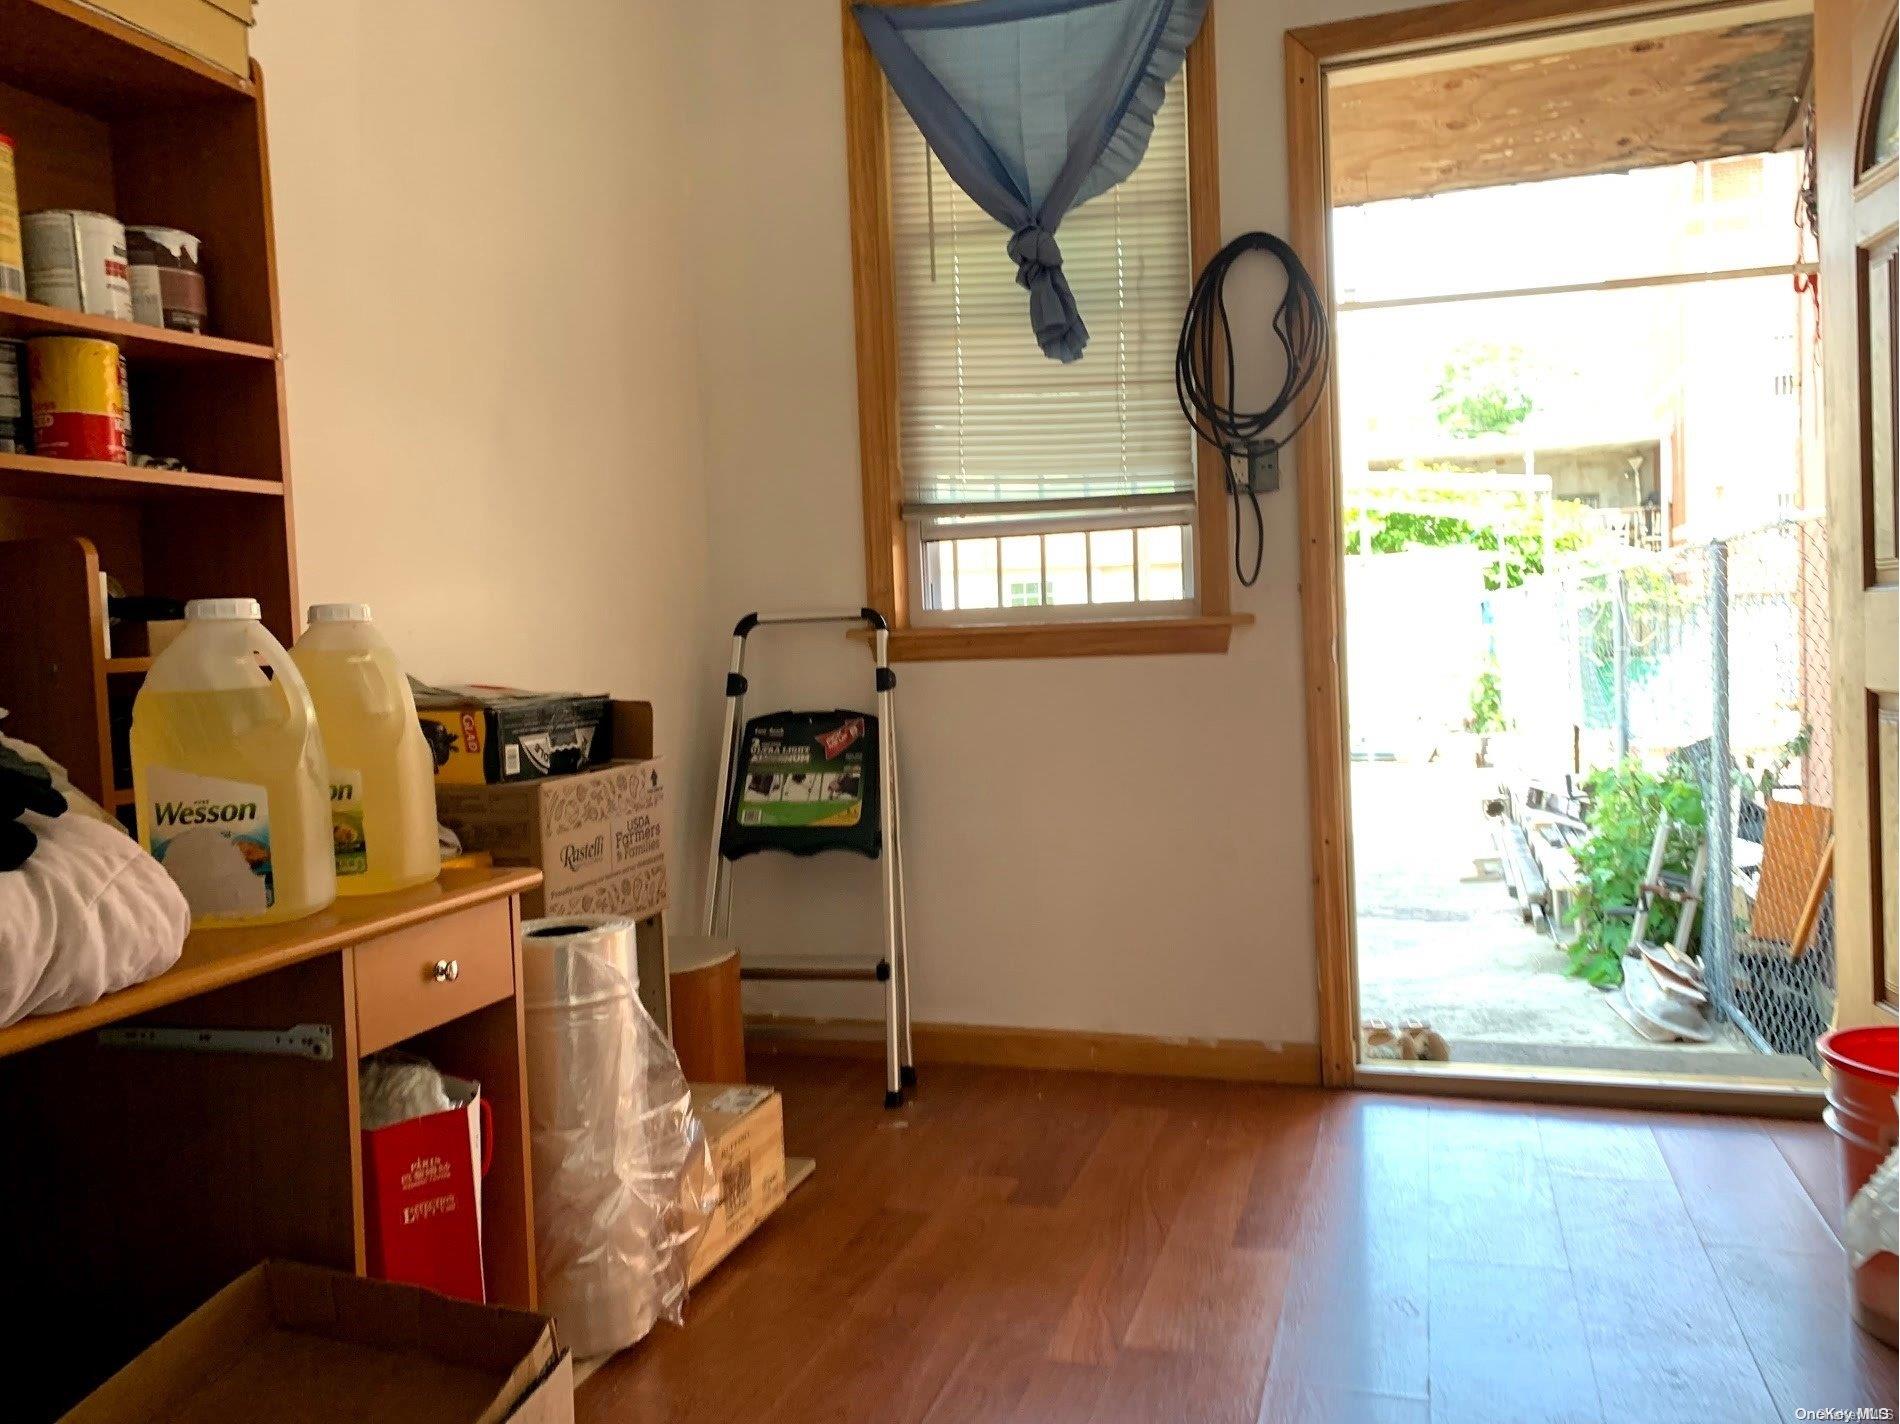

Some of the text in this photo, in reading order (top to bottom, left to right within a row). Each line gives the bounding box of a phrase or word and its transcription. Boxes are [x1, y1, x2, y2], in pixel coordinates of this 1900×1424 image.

[154, 802, 257, 825] Wesson
[627, 815, 650, 831] USDA
[615, 823, 661, 849] Farmers
